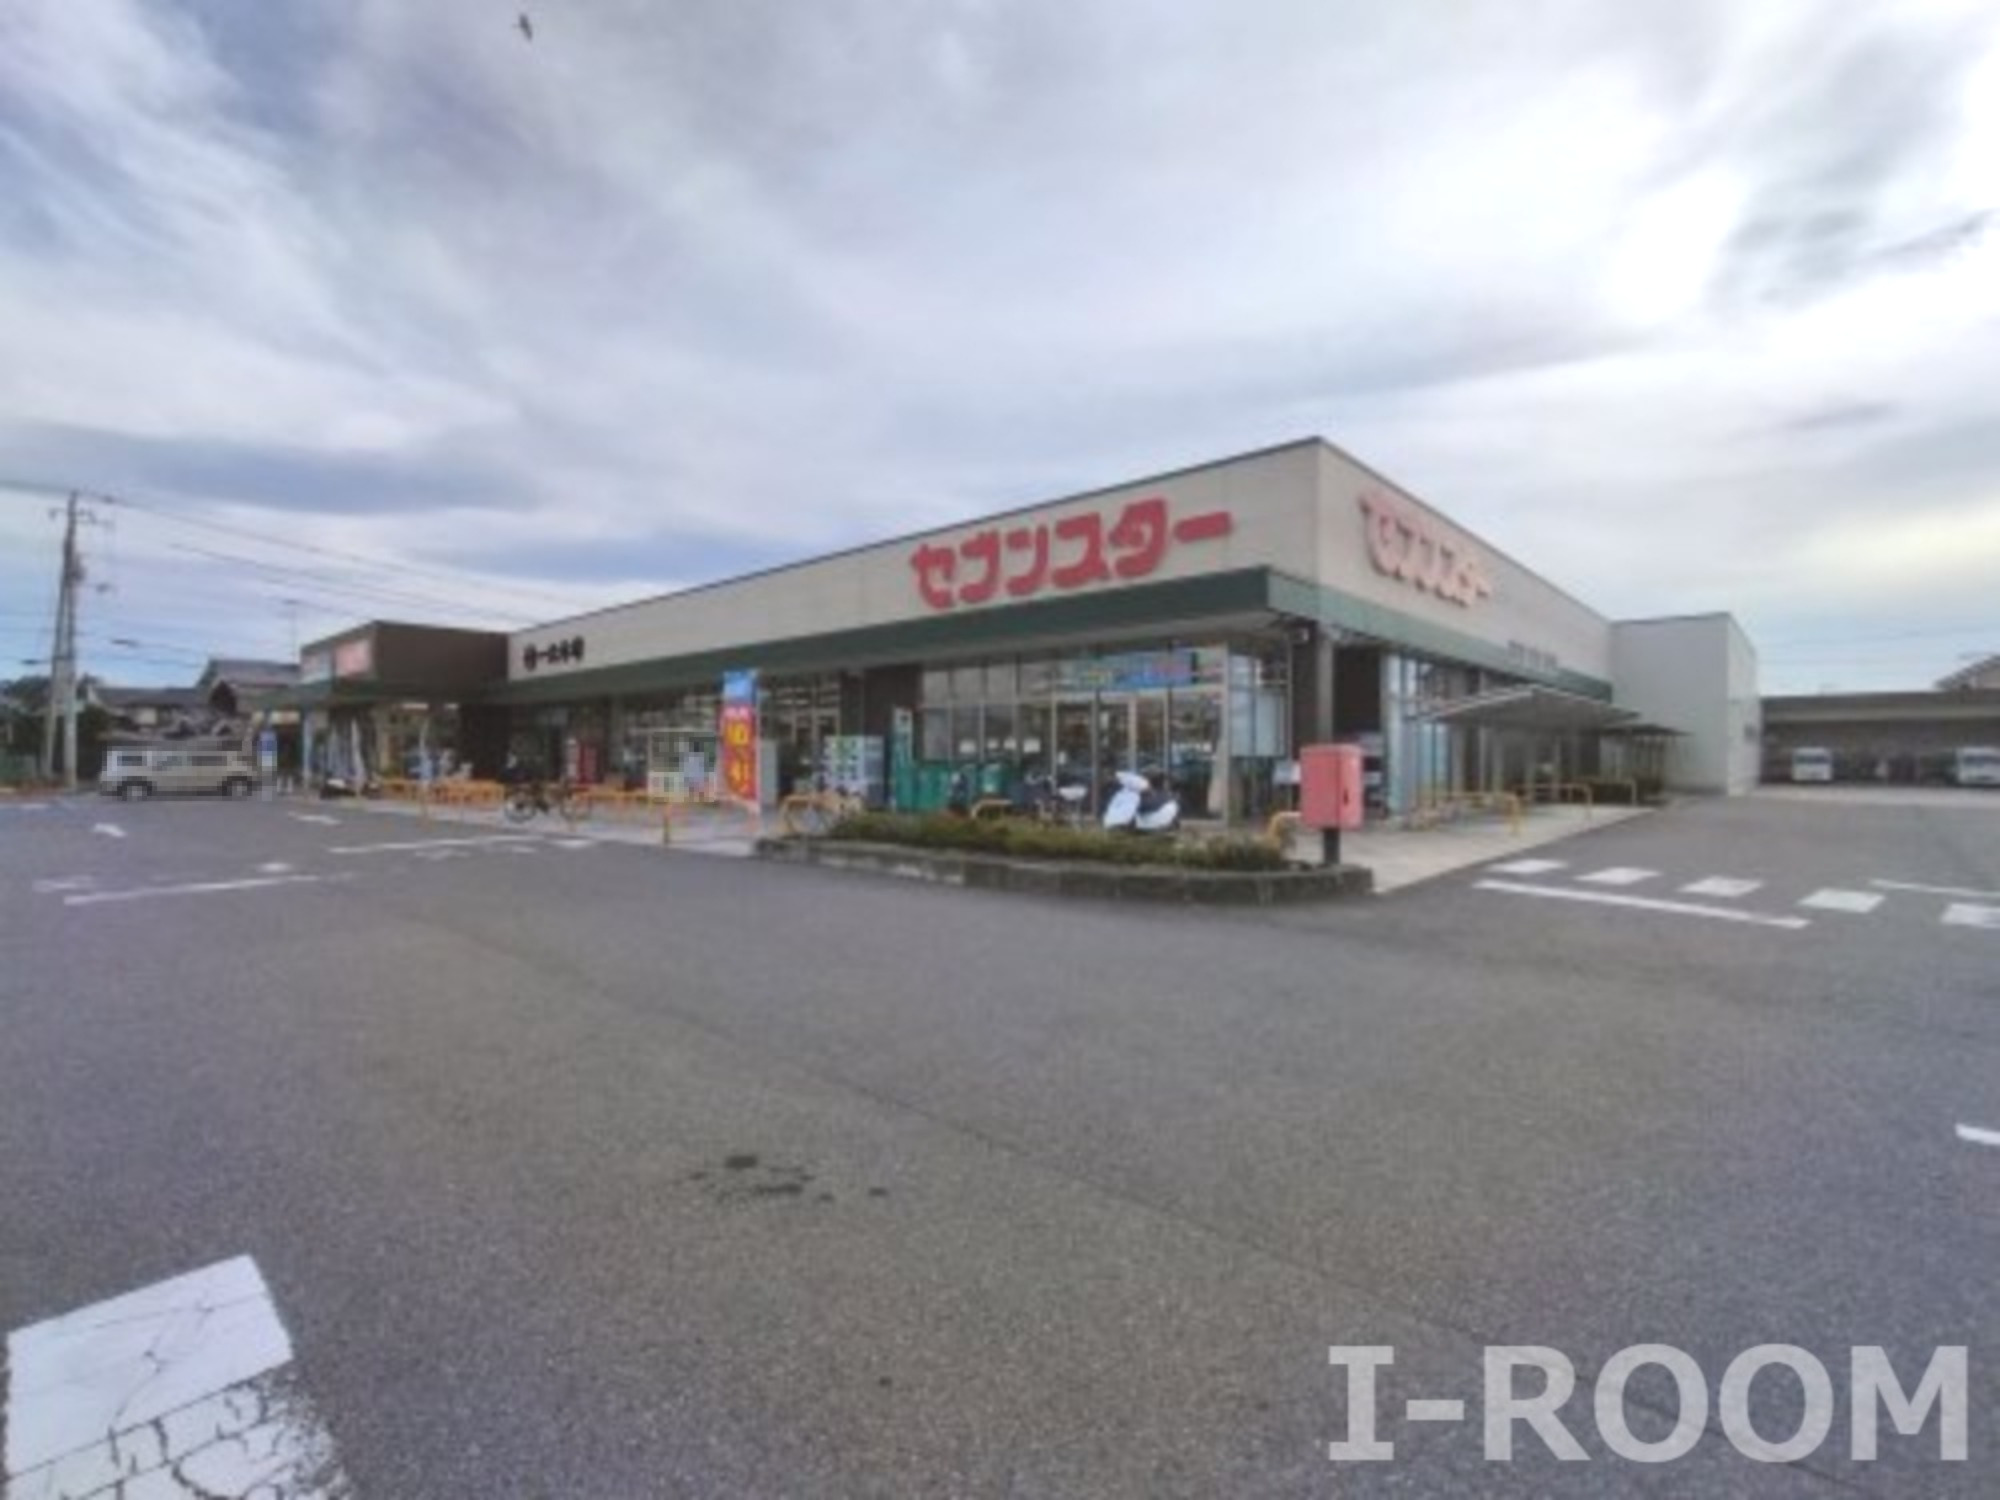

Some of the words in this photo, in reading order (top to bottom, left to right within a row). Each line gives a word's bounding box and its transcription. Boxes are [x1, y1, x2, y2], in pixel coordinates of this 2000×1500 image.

[911, 497, 1233, 609] セブンスター
